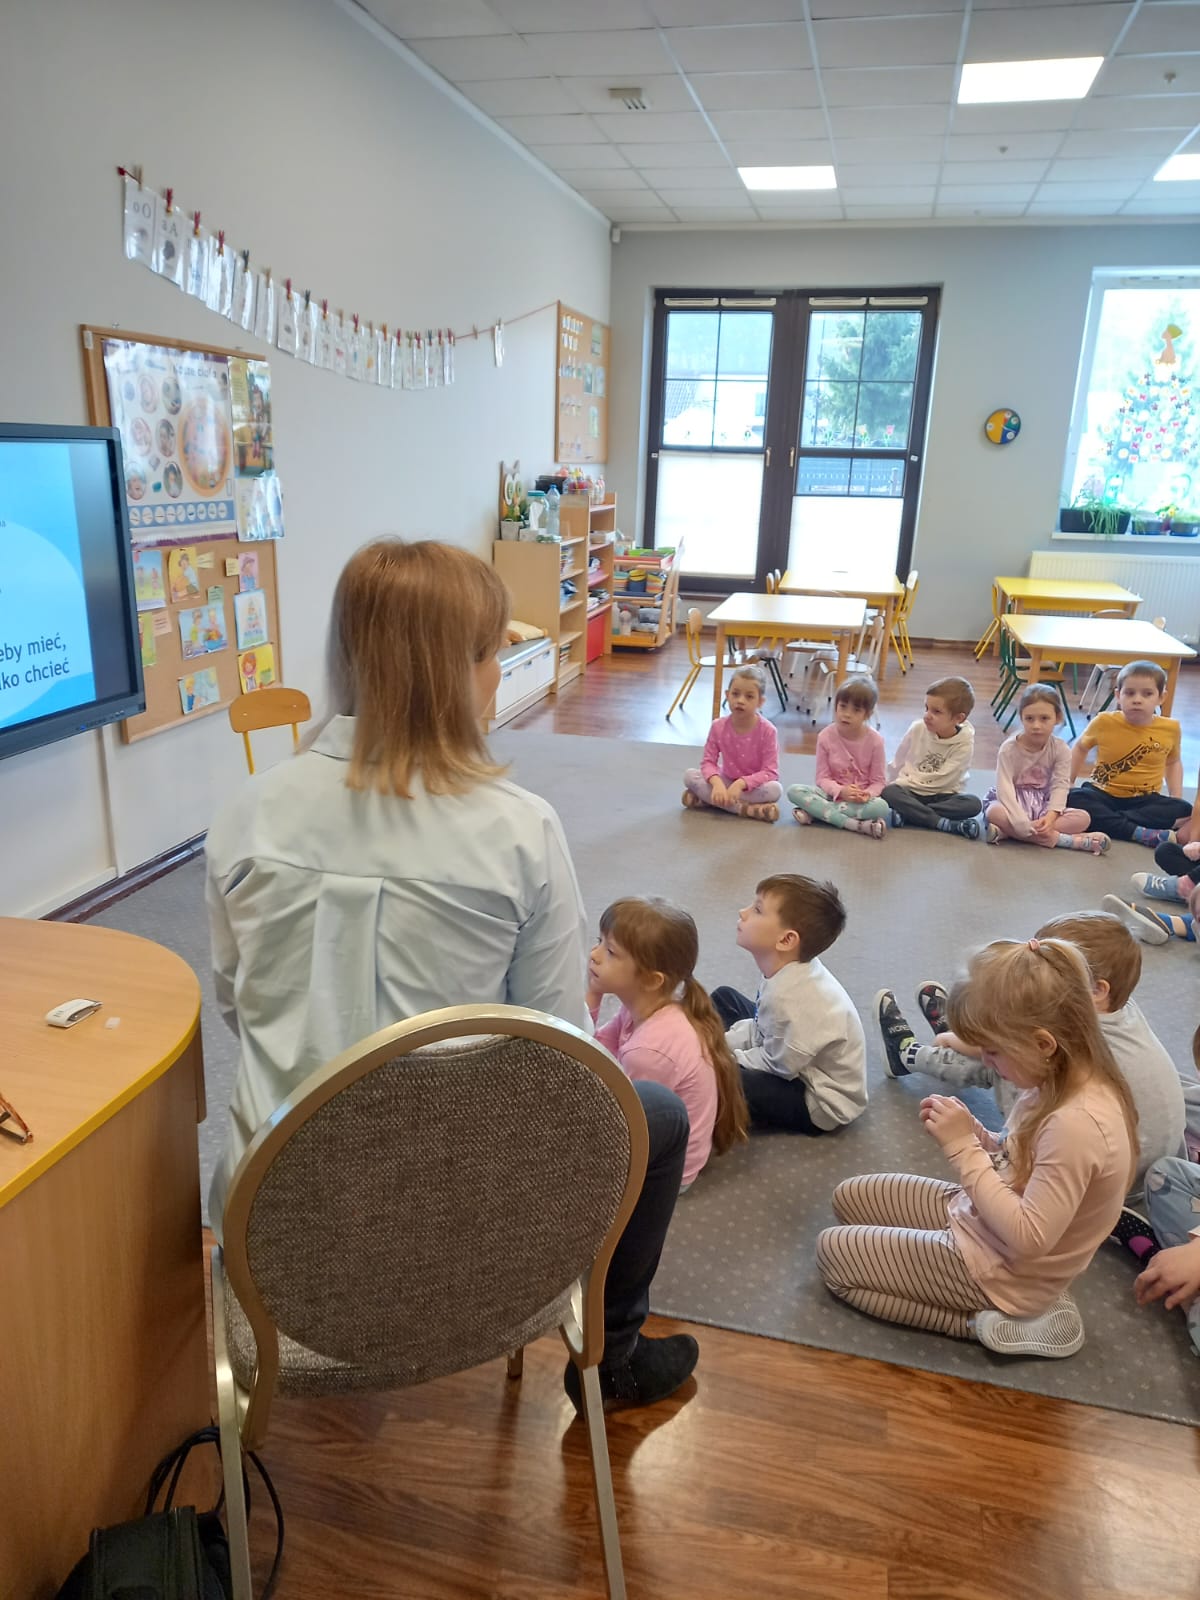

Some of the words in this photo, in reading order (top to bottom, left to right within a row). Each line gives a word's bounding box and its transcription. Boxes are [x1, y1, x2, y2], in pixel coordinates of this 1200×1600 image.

[27, 632, 66, 656] mieć,
[0, 671, 20, 690] ko
[25, 656, 70, 683] chcieć
